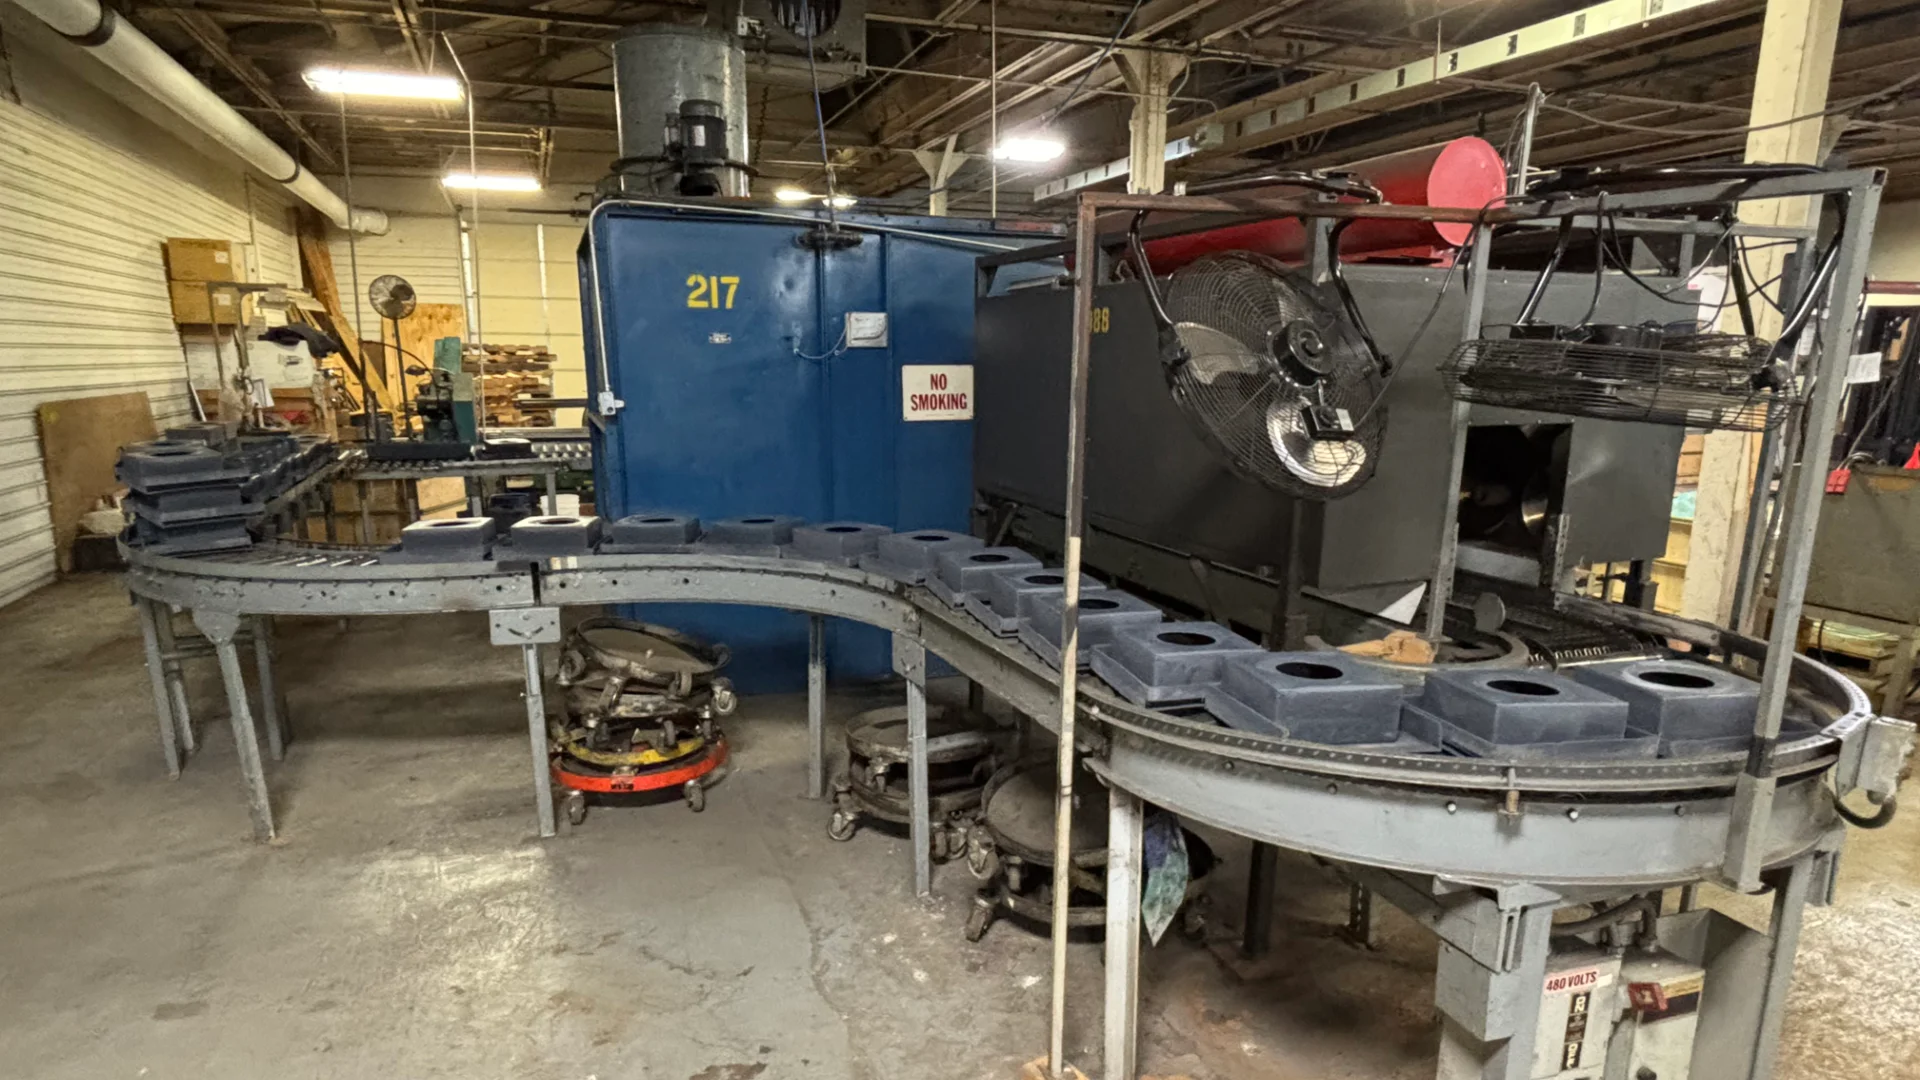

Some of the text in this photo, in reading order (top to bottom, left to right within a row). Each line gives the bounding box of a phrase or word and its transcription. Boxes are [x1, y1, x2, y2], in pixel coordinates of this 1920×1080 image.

[686, 274, 740, 309] 217
[1090, 307, 1109, 333] 88
[930, 373, 947, 390] NO
[910, 393, 967, 411] SMOKING
[1546, 971, 1597, 991] 480 VOLTS
[1574, 995, 1587, 1013] ON
